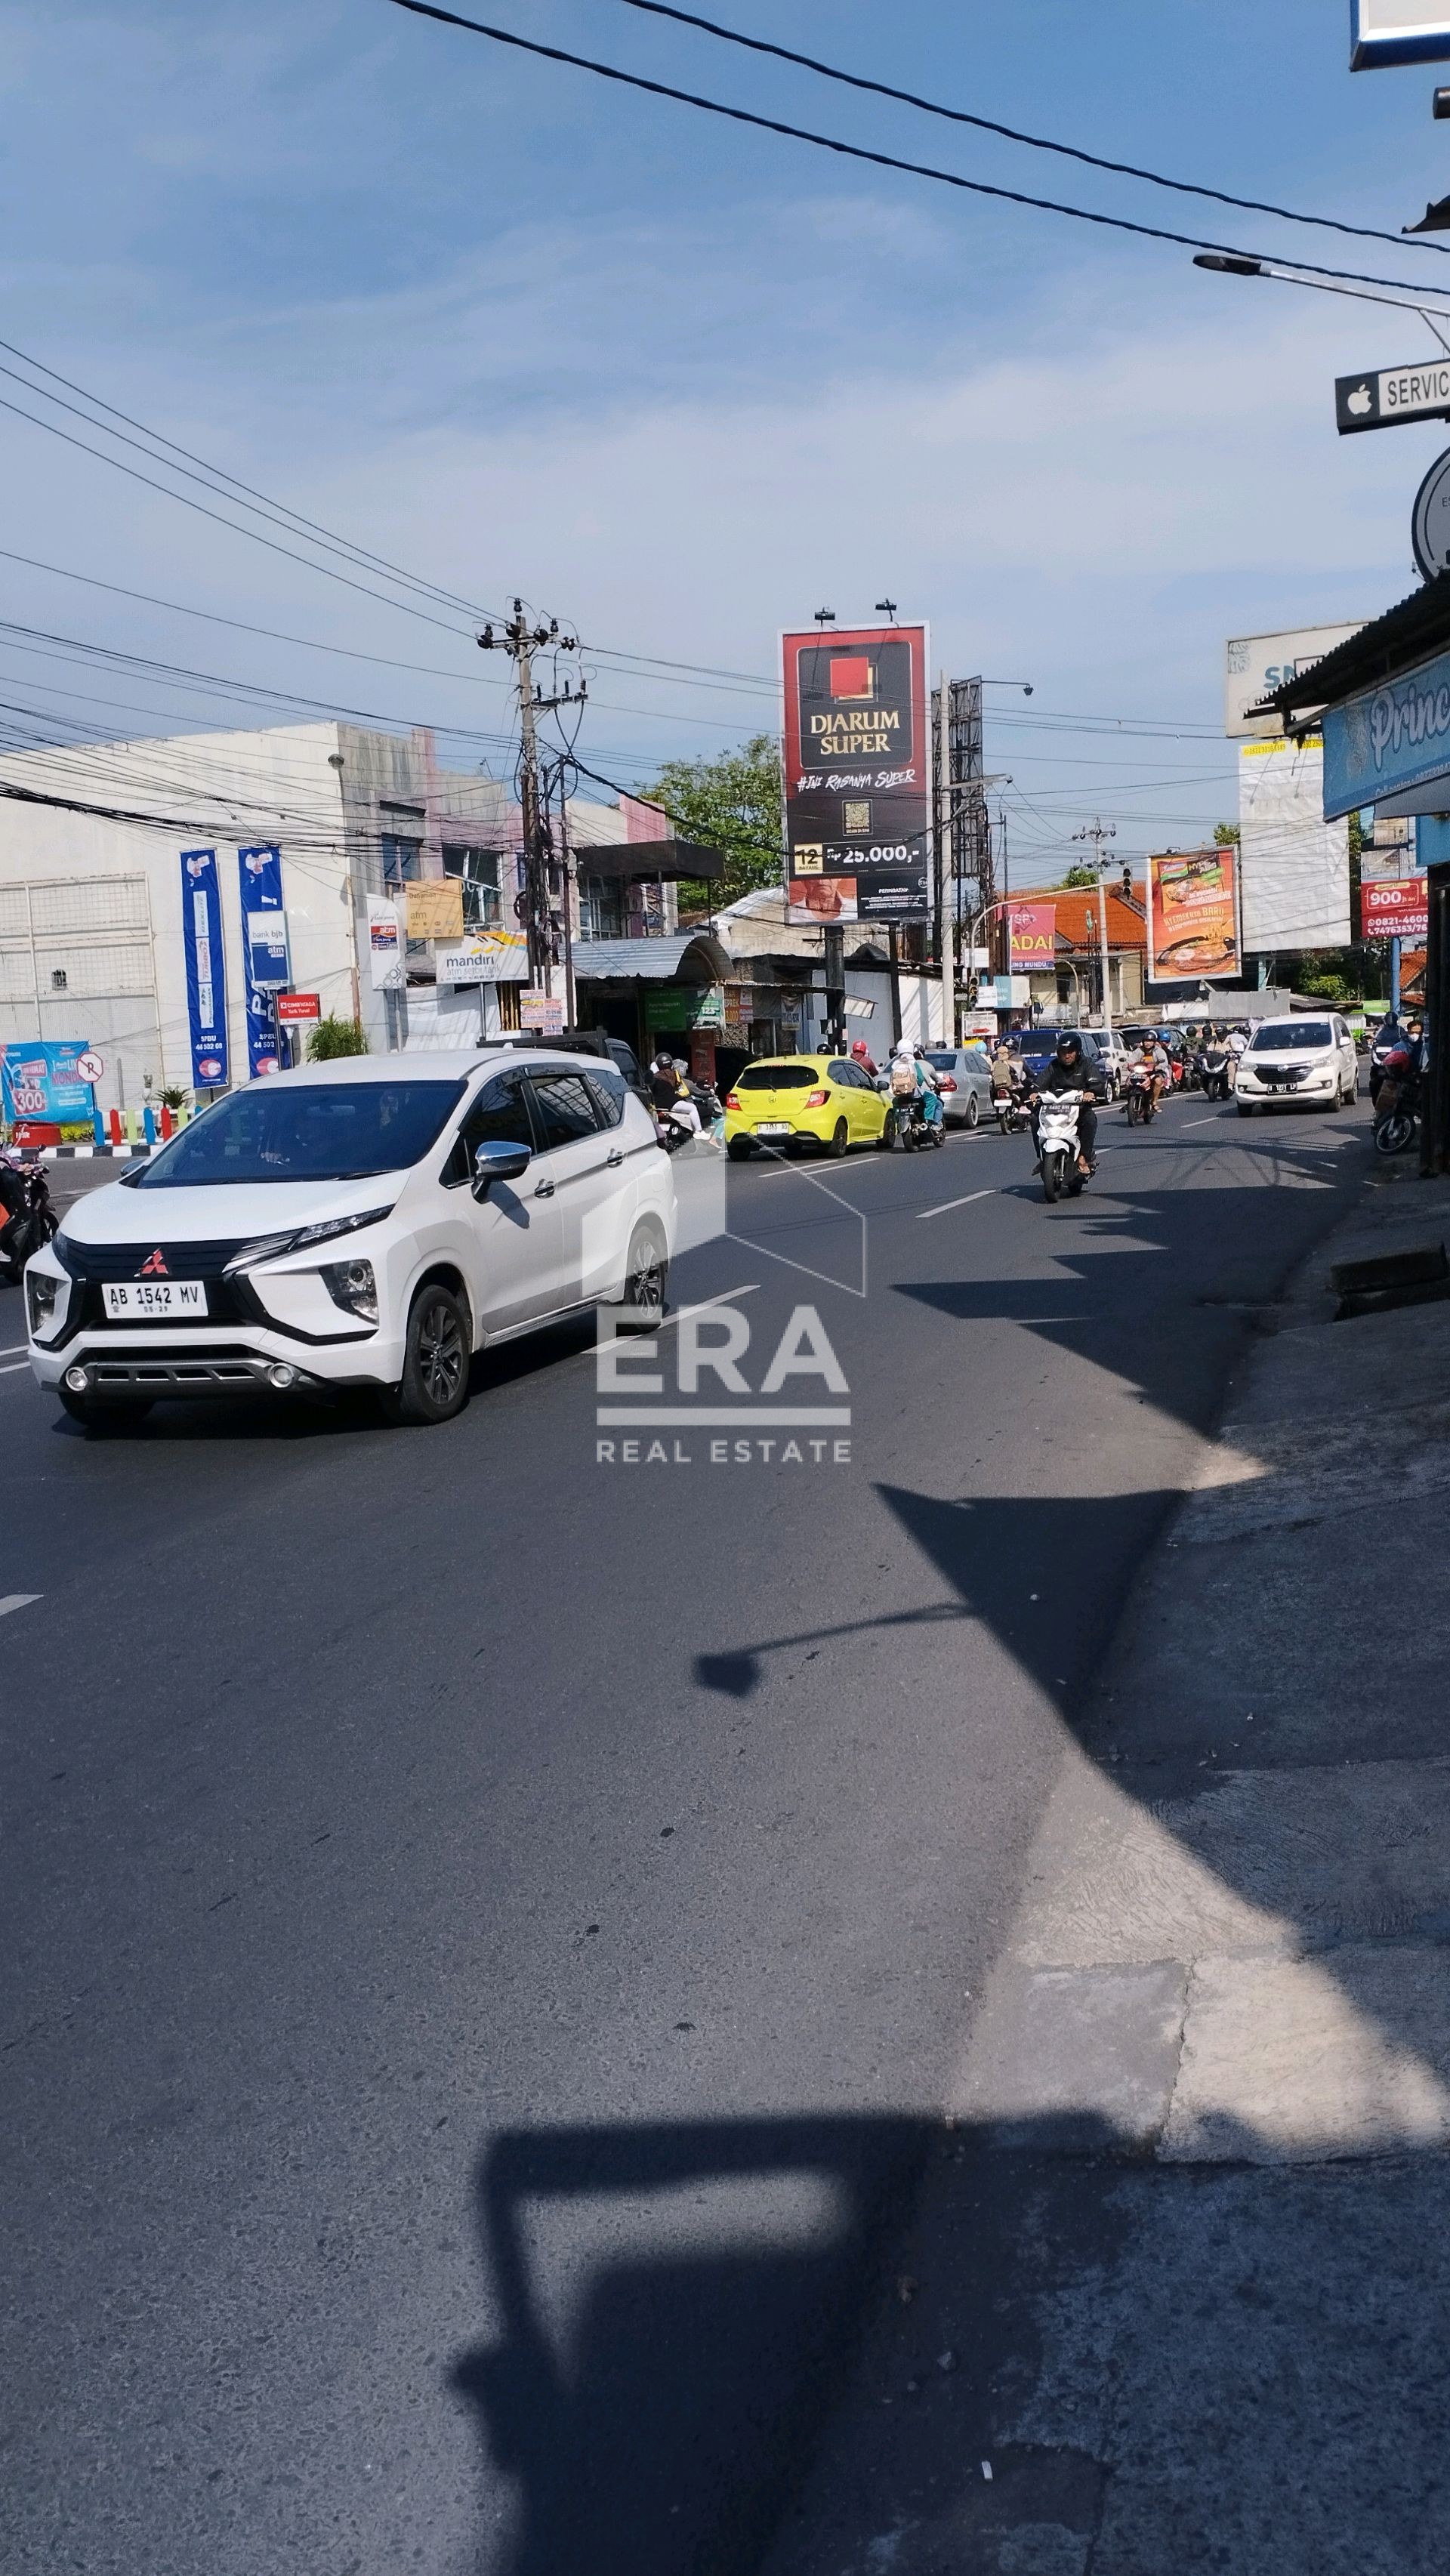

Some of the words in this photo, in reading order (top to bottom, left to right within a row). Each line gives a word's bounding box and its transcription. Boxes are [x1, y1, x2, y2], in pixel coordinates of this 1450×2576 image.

[810, 710, 900, 734] DJARUM
[820, 733, 891, 755] SUPER
[825, 773, 872, 791] RASANYA
[875, 769, 917, 788] SUPER
[798, 849, 818, 865] 12
[1370, 891, 1401, 905] 900
[271, 930, 283, 939] bjb
[267, 946, 284, 954] atm
[446, 954, 494, 967] mandiri
[18, 1092, 42, 1112] 300
[111, 1288, 128, 1305] AB
[136, 1287, 171, 1304] 1542
[180, 1286, 198, 1303] MV
